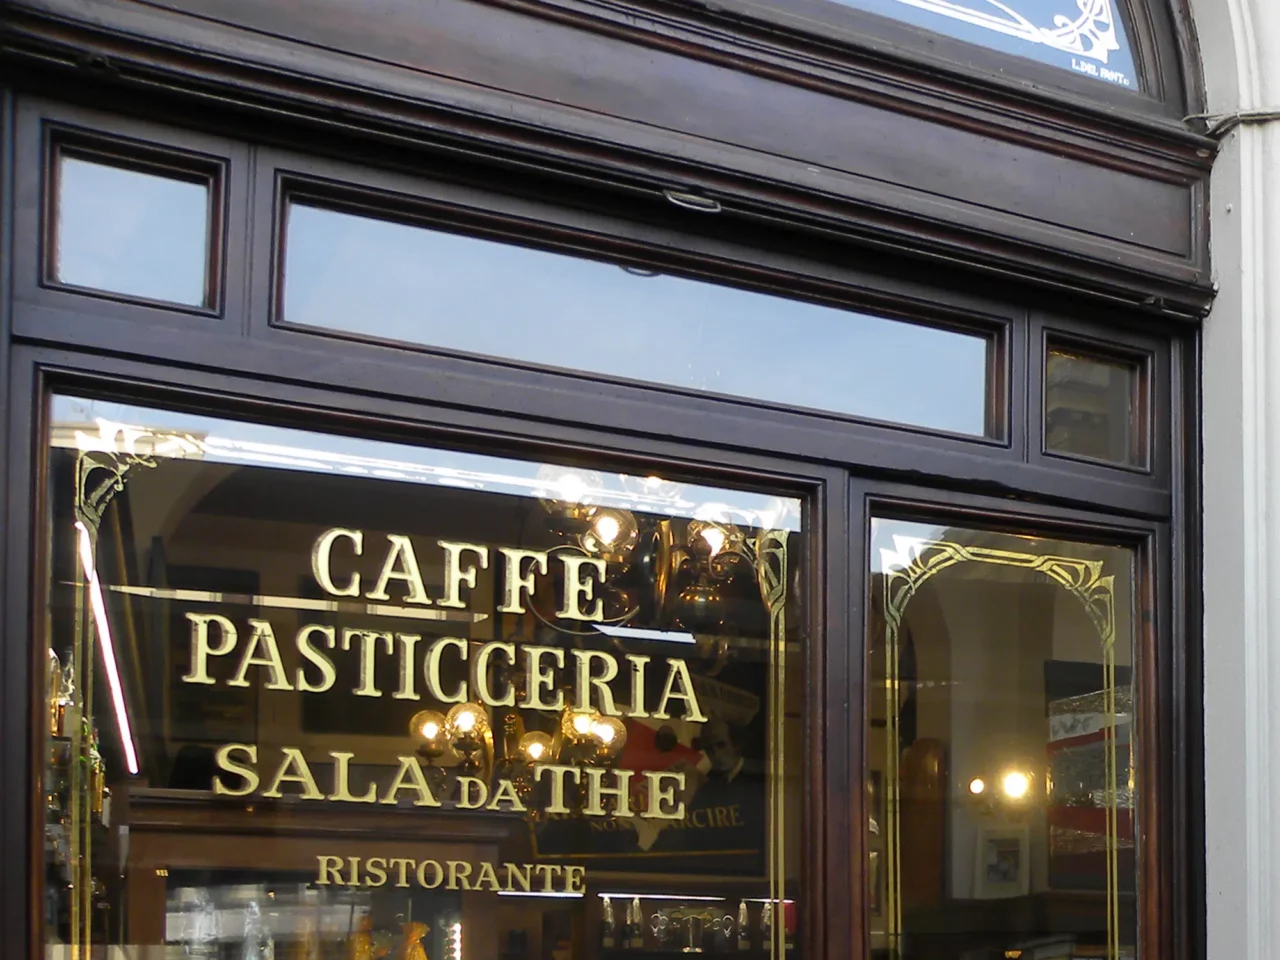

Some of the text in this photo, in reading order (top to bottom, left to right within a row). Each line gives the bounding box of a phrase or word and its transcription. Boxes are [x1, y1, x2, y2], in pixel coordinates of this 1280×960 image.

[181, 611, 709, 723] PASTICCERIA
[213, 742, 686, 820] SALA DA THE
[314, 854, 587, 895] RISTORANTE
